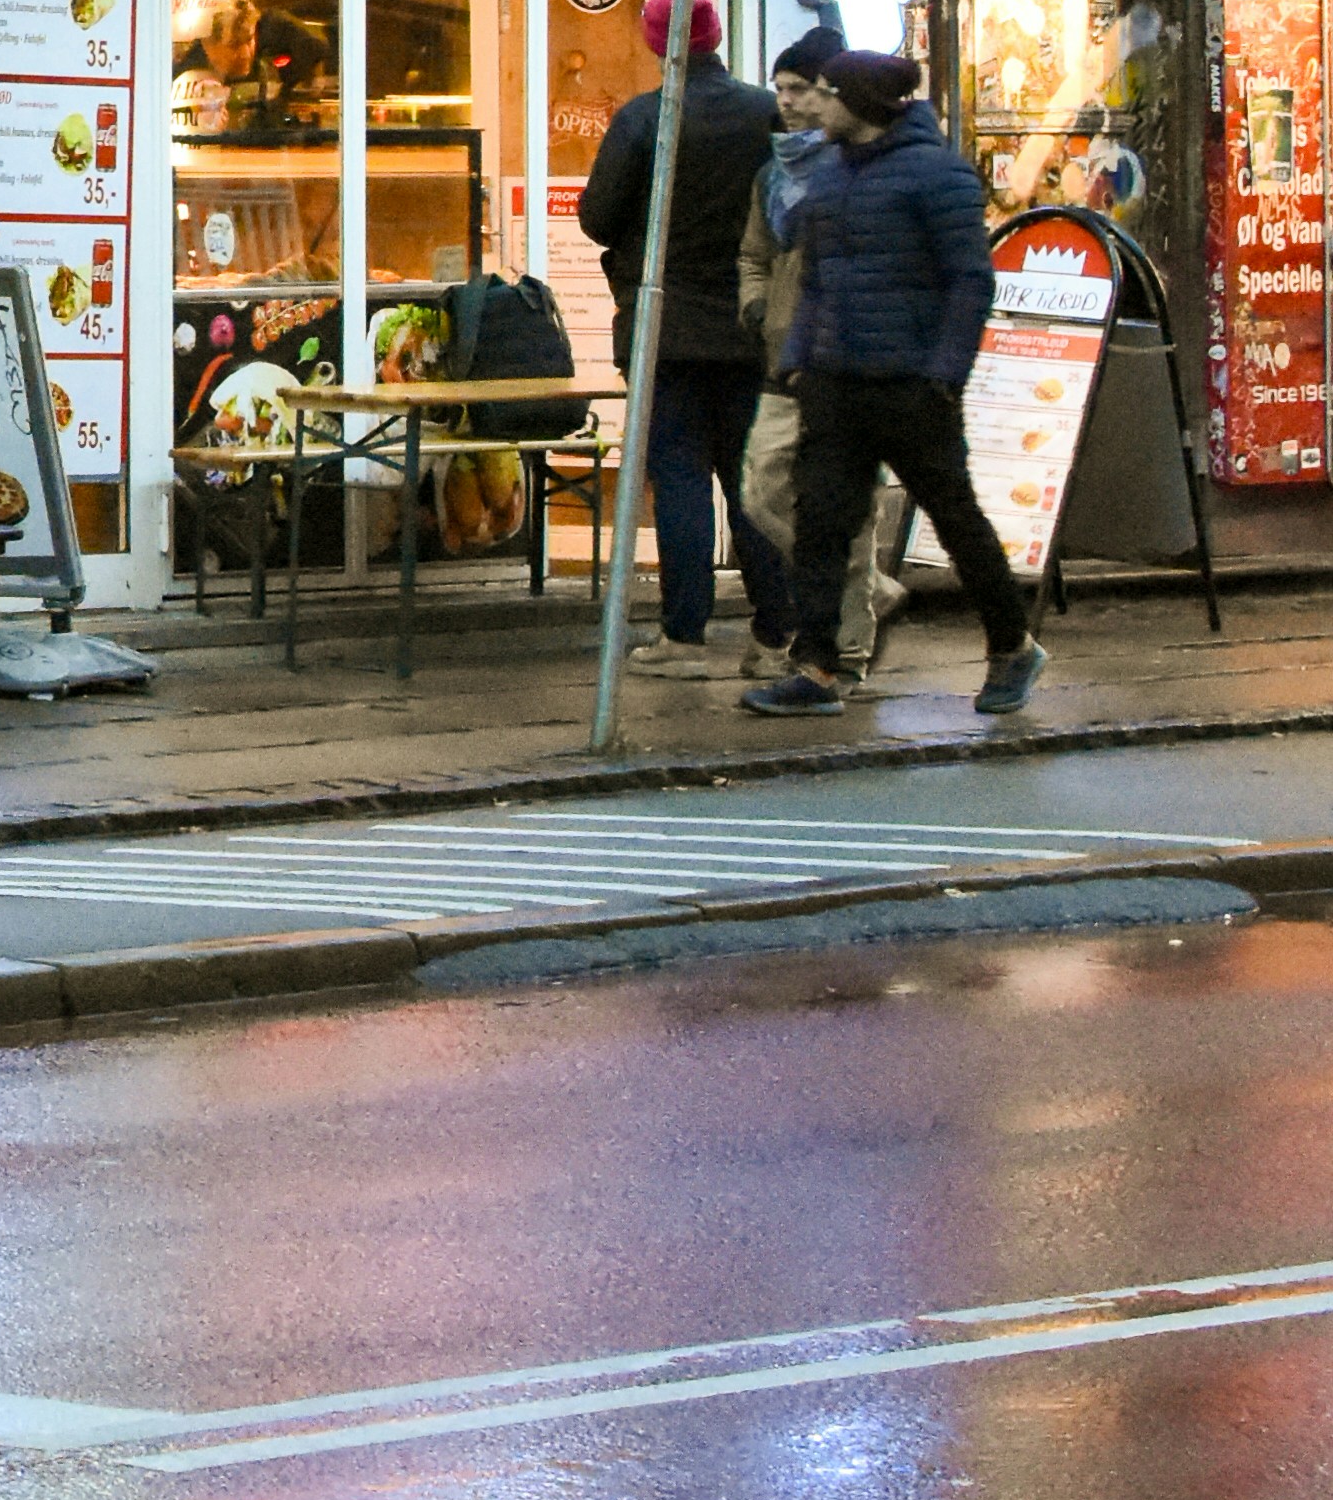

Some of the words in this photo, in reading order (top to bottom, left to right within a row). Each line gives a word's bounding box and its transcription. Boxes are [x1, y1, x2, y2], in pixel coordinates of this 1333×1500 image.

[1238, 263, 1322, 300] Specielle
[80, 314, 114, 344] 45,-
[1252, 385, 1299, 403] Since
[77, 421, 111, 454] 55,-
